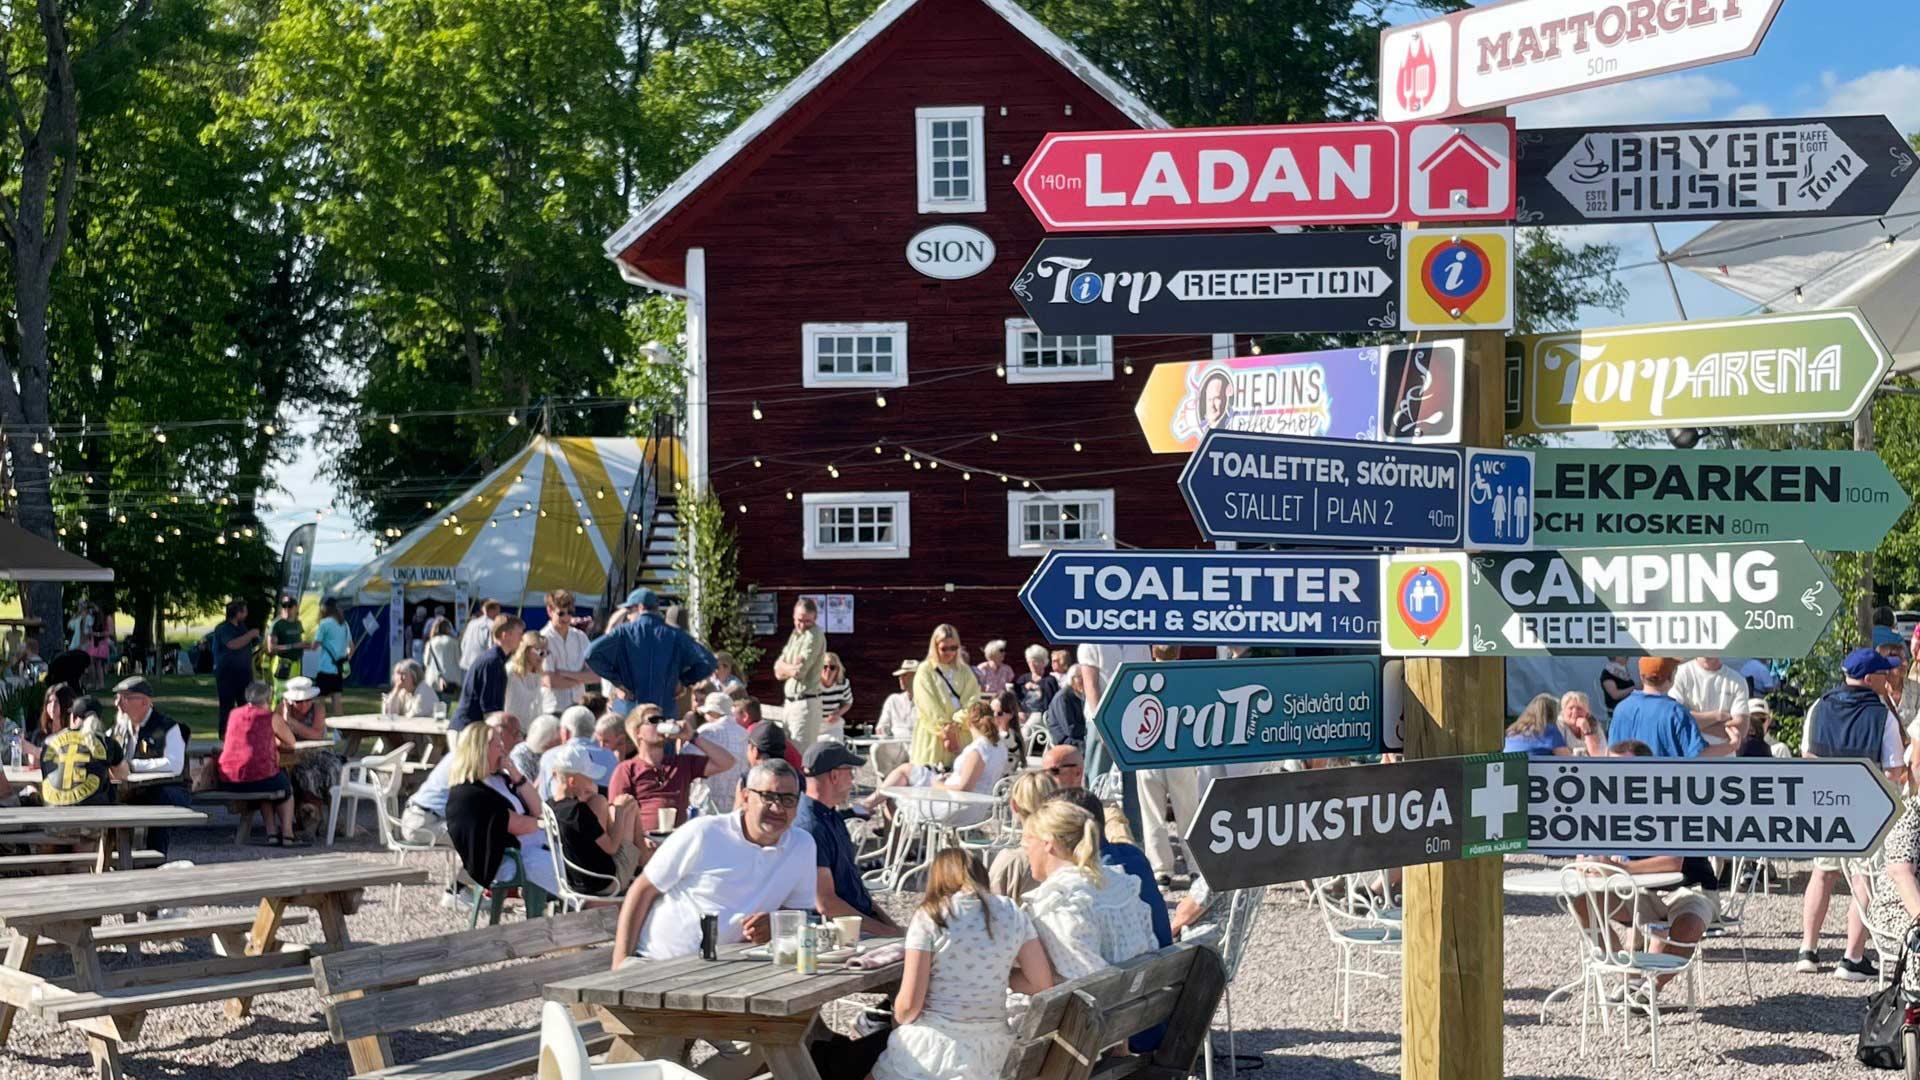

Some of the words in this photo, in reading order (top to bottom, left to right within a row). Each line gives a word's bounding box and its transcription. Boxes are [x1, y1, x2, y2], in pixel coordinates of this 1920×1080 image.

[1586, 56, 1618, 77] 50m
[1611, 130, 1797, 172] BRYGG
[1800, 131, 1828, 141] KAFFE
[1806, 142, 1828, 152] GOTT
[1040, 174, 1082, 191] 140m
[1085, 144, 1371, 207] LADAN
[1611, 171, 1798, 212] HUSET
[1798, 154, 1852, 201] Torp
[1586, 201, 1608, 212] 2022
[916, 241, 985, 263] SION
[1184, 268, 1375, 297] RECEPTION
[1236, 369, 1321, 407] HEDINS
[1208, 452, 1350, 487] TOALETTER,
[1357, 456, 1455, 490] SKÖTRUM
[1224, 492, 1303, 522] STALLET
[1328, 498, 1377, 525] PLAN
[1384, 499, 1394, 526] 2
[1428, 510, 1455, 528] 40m
[1845, 487, 1889, 504] 100m
[1597, 512, 1725, 536] KIOSKEN
[1731, 518, 1770, 535] 80m
[1065, 565, 1361, 603] TOALETTER
[1500, 549, 1778, 607] CAMPING
[1066, 609, 1156, 631] DUSCH
[1165, 609, 1184, 632] &
[1193, 604, 1322, 633] SKÖTRUM
[1519, 615, 1718, 645] RECEPTION
[1744, 610, 1794, 630] 250m
[1283, 692, 1343, 719] Själavård
[1348, 690, 1370, 711] och
[1261, 720, 1302, 745] andlig
[1528, 766, 1804, 806] BÖNEHUSET
[1812, 790, 1851, 806] 125m
[1209, 787, 1452, 855] SJUKSTUGA
[1528, 806, 1856, 844] BÖNESTENARNA
[1425, 837, 1451, 855] 60m
